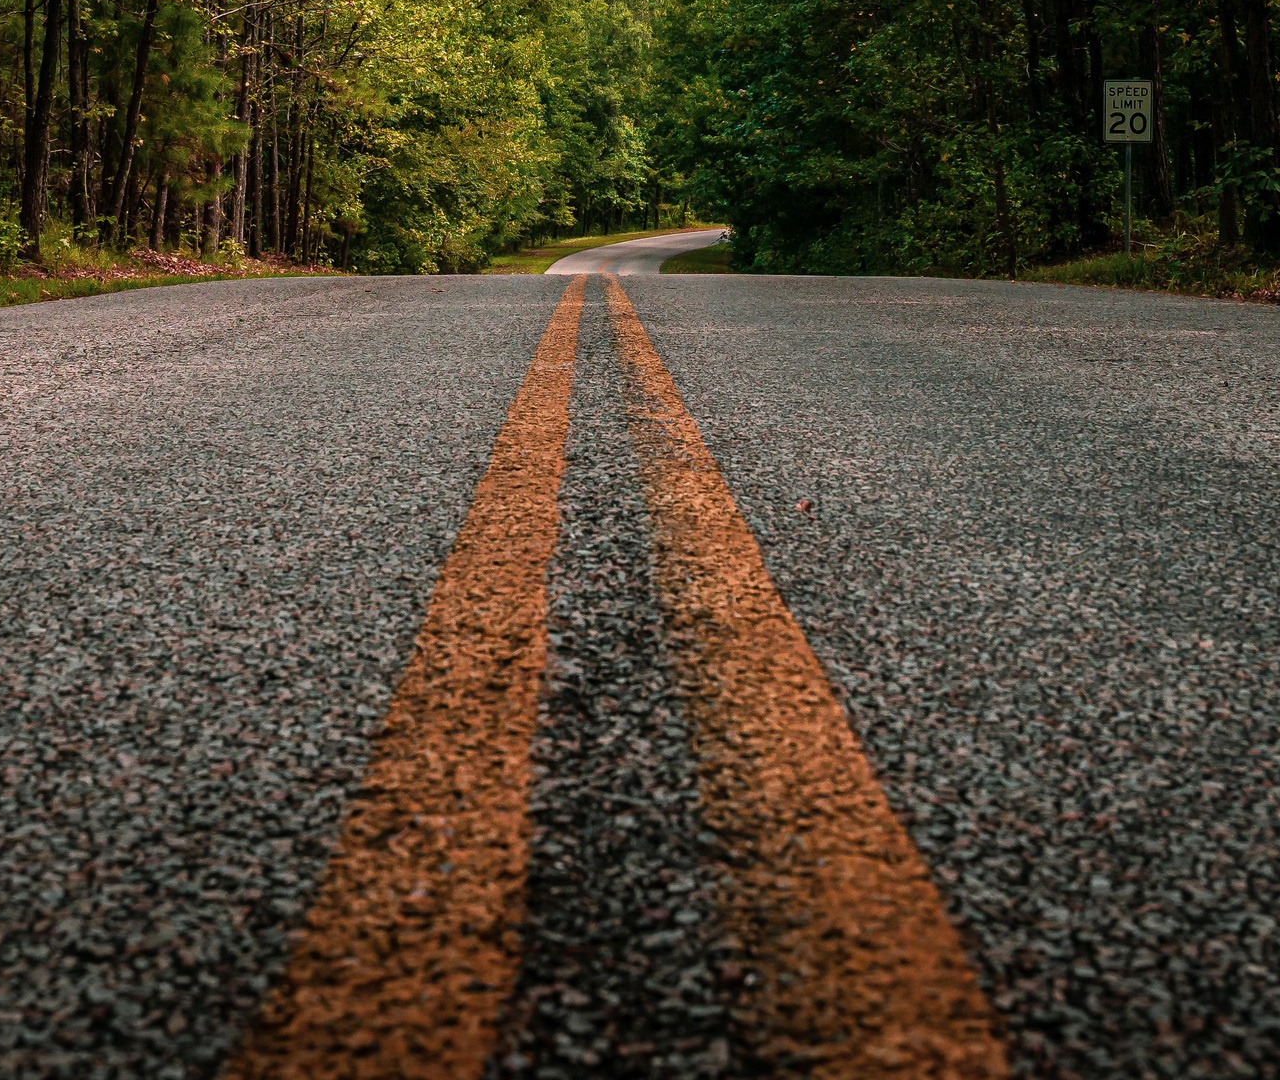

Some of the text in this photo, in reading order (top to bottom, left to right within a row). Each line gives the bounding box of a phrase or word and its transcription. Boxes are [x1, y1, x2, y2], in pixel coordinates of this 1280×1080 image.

[1109, 87, 1148, 97] SPEED
[1113, 100, 1143, 109] LIMIT
[1109, 112, 1147, 134] 20
